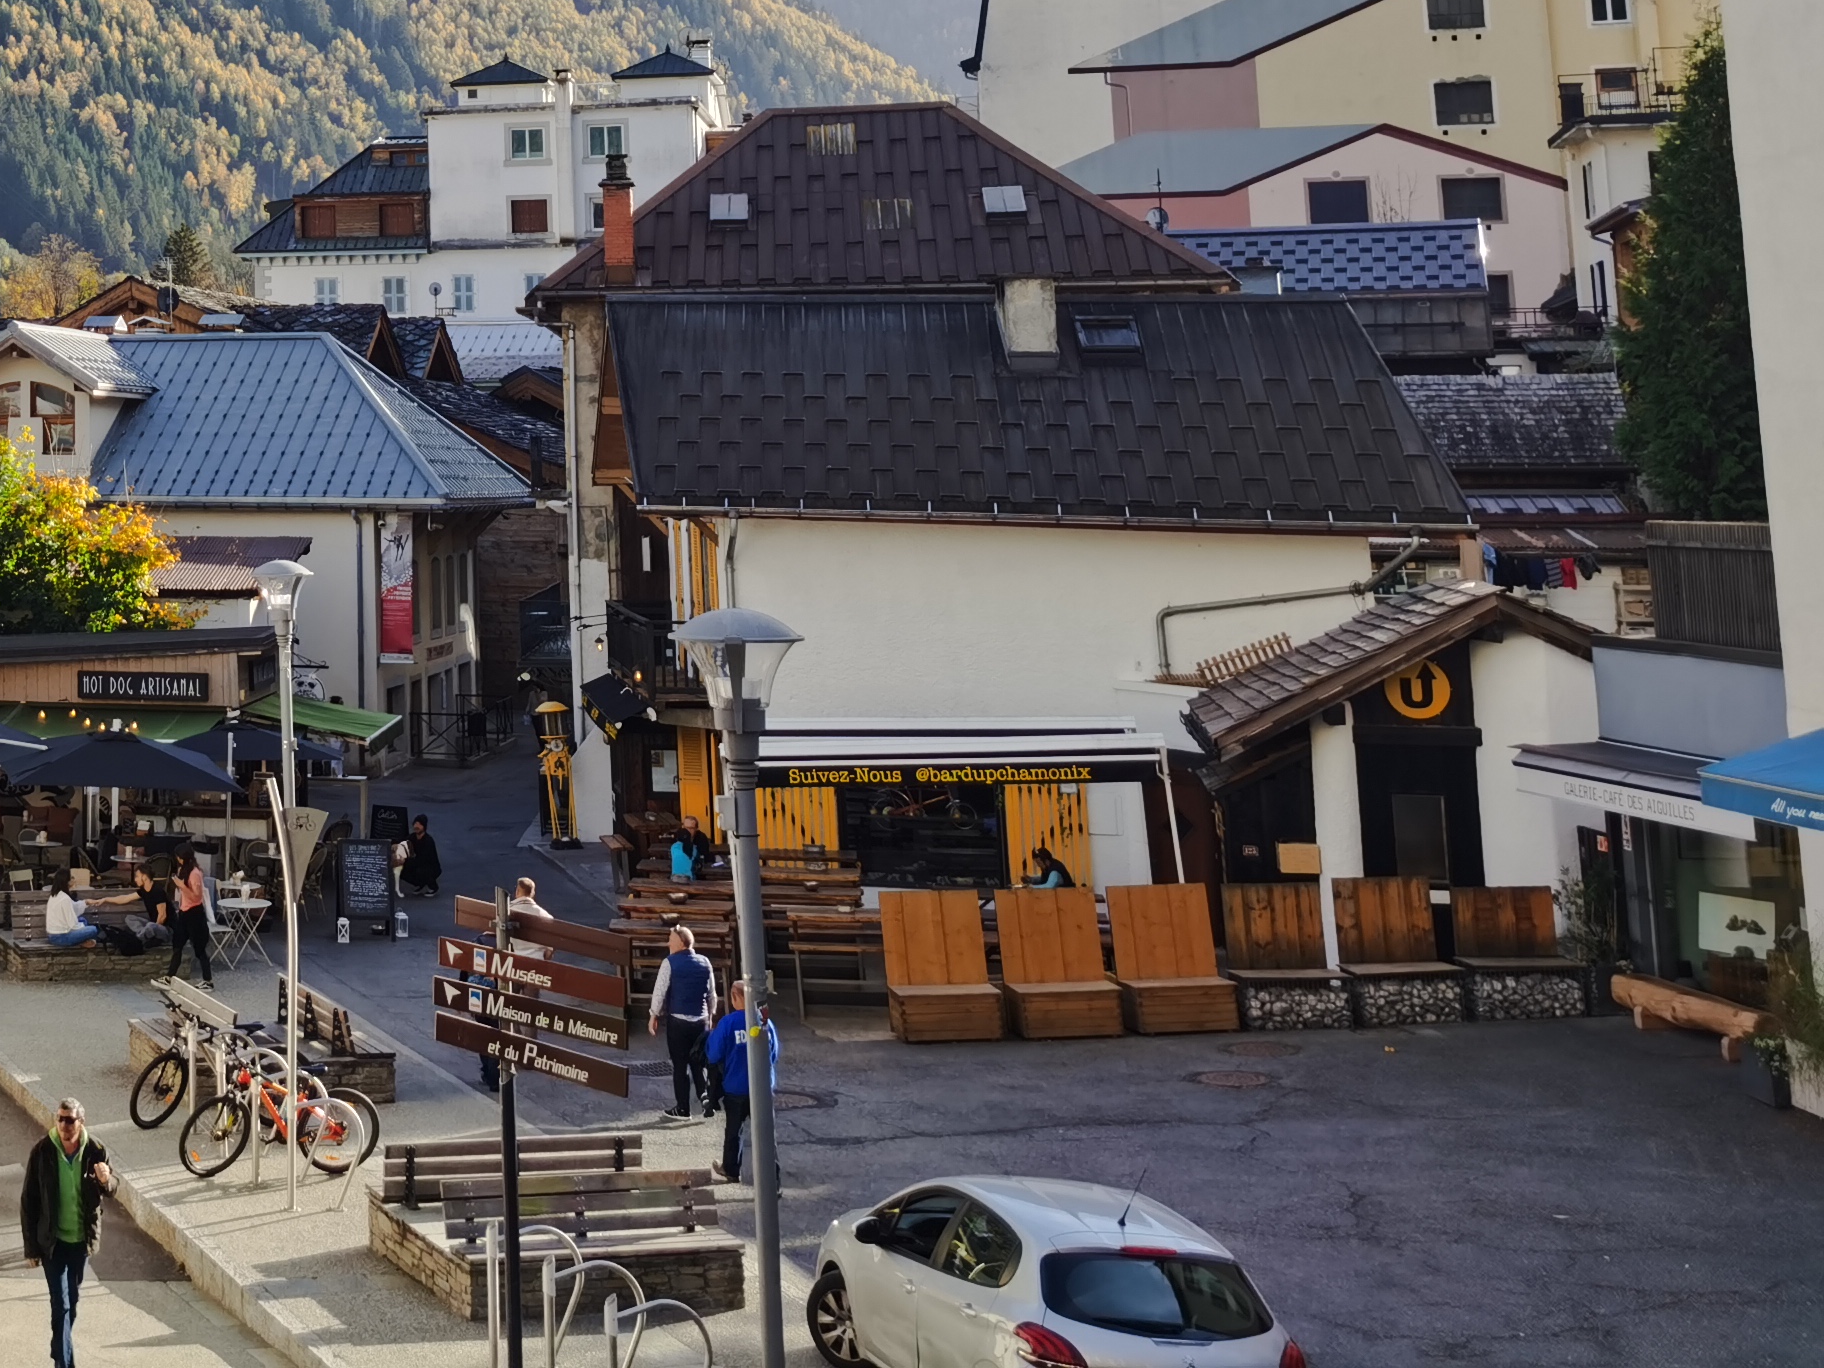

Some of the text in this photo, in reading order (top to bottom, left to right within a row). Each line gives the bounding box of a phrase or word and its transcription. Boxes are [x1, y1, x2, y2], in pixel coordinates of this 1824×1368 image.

[82, 675, 202, 697] HOT DOG ARTISANAL
[788, 764, 1092, 785] Suivez-Nous @bardupchamonix
[1563, 781, 1695, 822] GALERIE-CAFÉ DES AIGUILLES
[1770, 797, 1787, 814] All
[1785, 806, 1807, 820] you
[490, 953, 553, 988] Musées
[486, 993, 618, 1045] Maison de la Mémoire
[487, 1041, 589, 1083] et du Patrimoine
